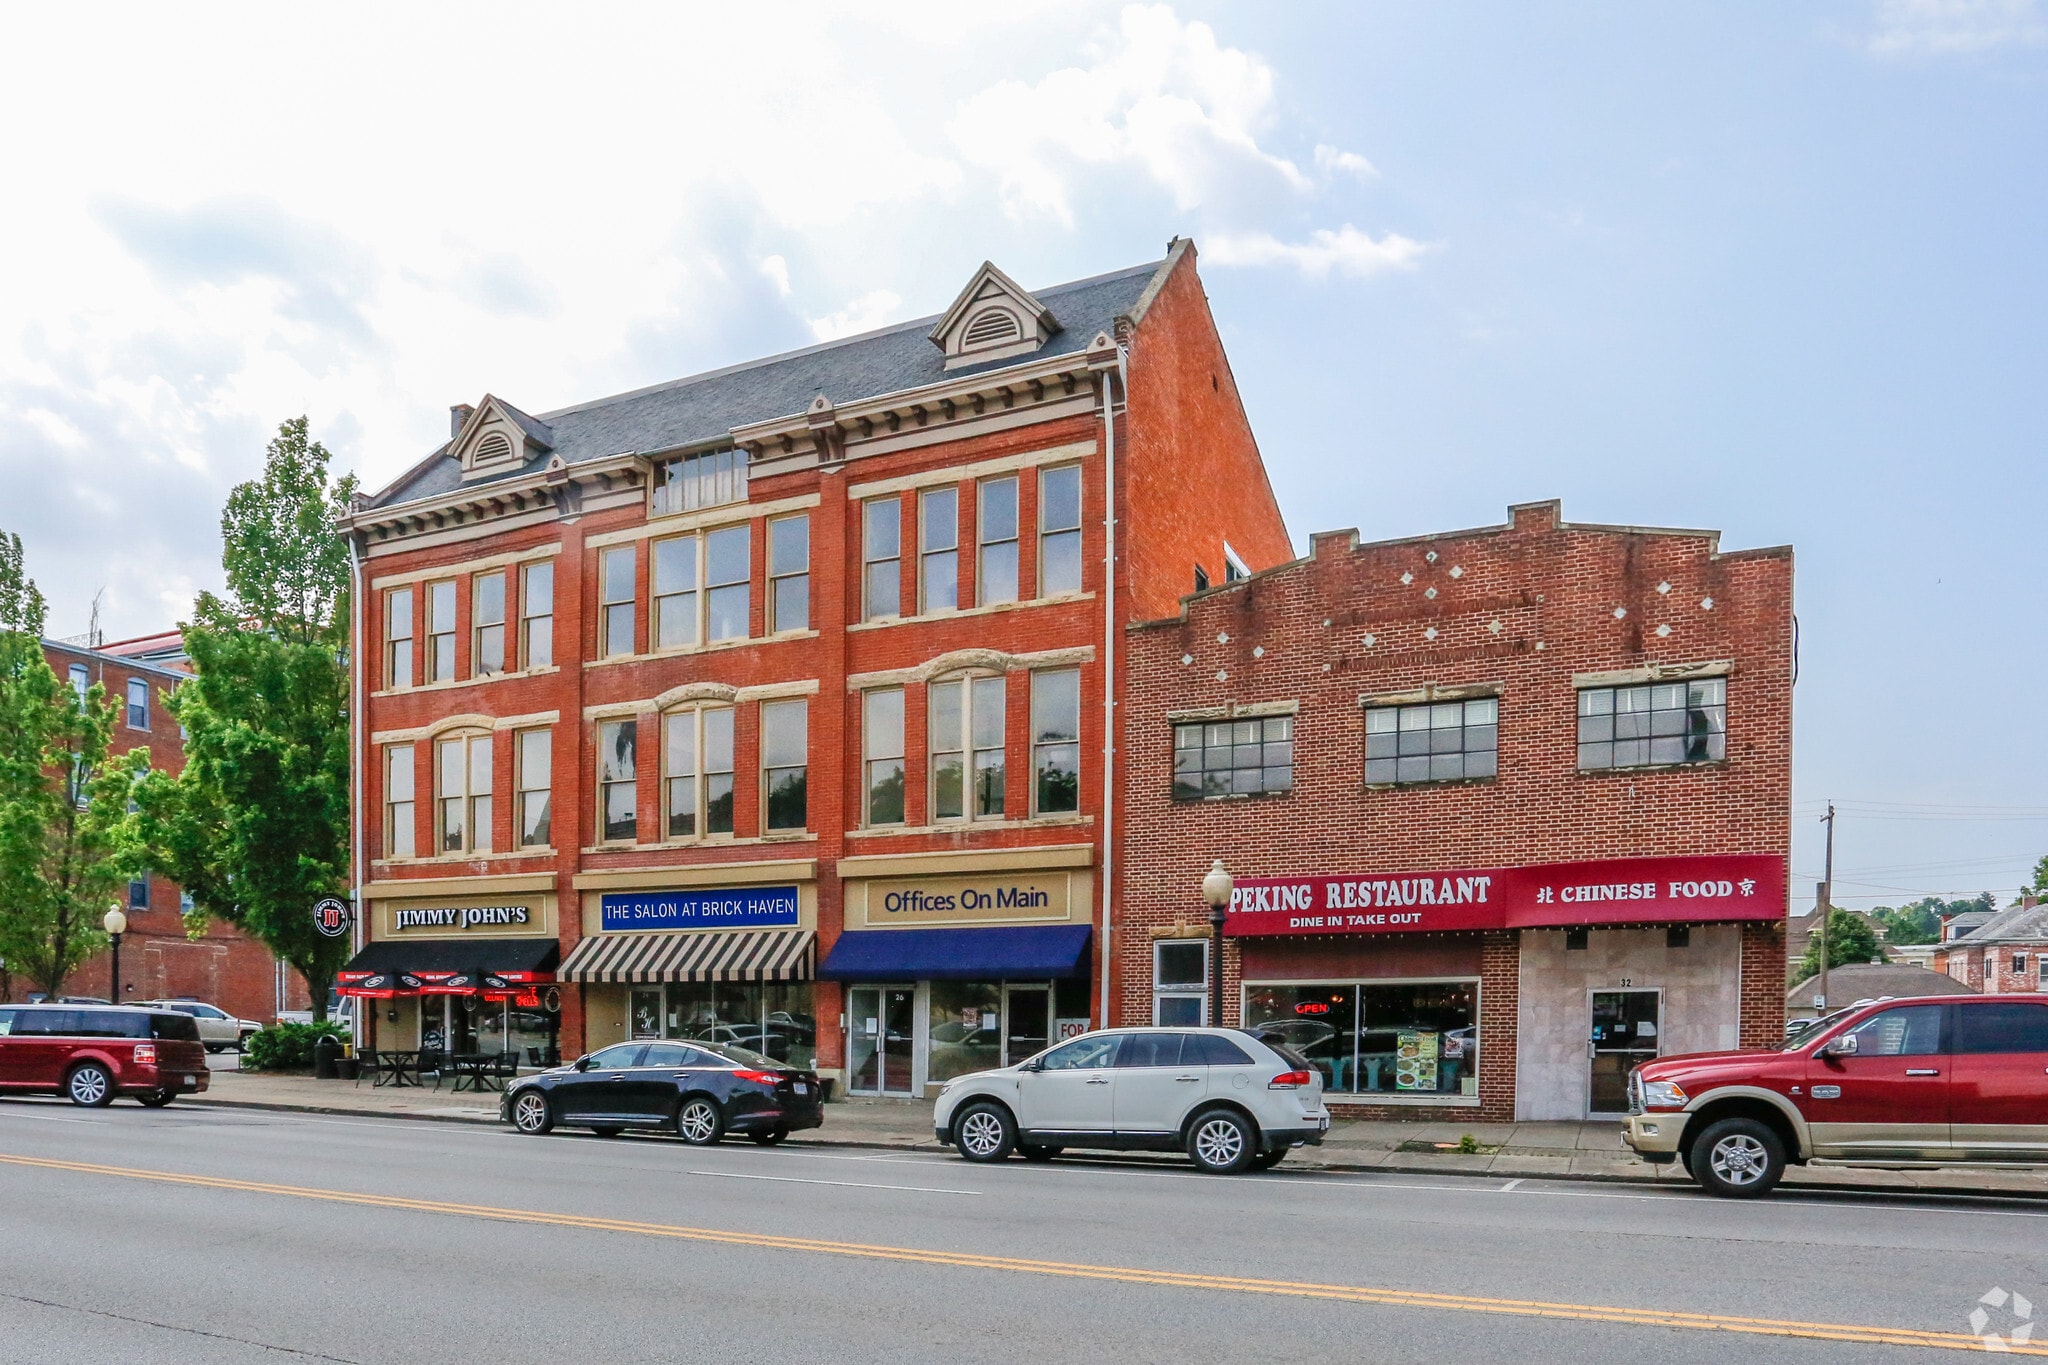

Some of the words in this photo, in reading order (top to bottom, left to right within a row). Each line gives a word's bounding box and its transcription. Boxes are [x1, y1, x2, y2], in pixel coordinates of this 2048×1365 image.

[1228, 884, 1313, 913] PEKING
[1326, 876, 1491, 909] RESTAURANT
[1560, 883, 1656, 903] CHINESE
[1669, 880, 1733, 898] FOOD
[1737, 878, 1756, 897] 京
[605, 904, 630, 919] THE
[634, 903, 677, 918] SALON
[681, 902, 697, 917] AT
[702, 900, 742, 916] BRICK
[748, 898, 794, 914] HAVEN
[884, 890, 956, 912] Offices
[960, 889, 991, 910] On
[996, 886, 1048, 908] Main
[323, 909, 339, 927] JJ
[396, 909, 456, 929] JIMMY
[461, 907, 527, 928] JOHN'S
[1290, 917, 1323, 928] DINE
[1327, 916, 1343, 926] IN
[1347, 914, 1385, 925] TAKE
[1389, 913, 1422, 924] OUT
[1621, 979, 1632, 987] 32
[1295, 1003, 1328, 1014] OPEN
[1061, 1023, 1084, 1038] FOR
